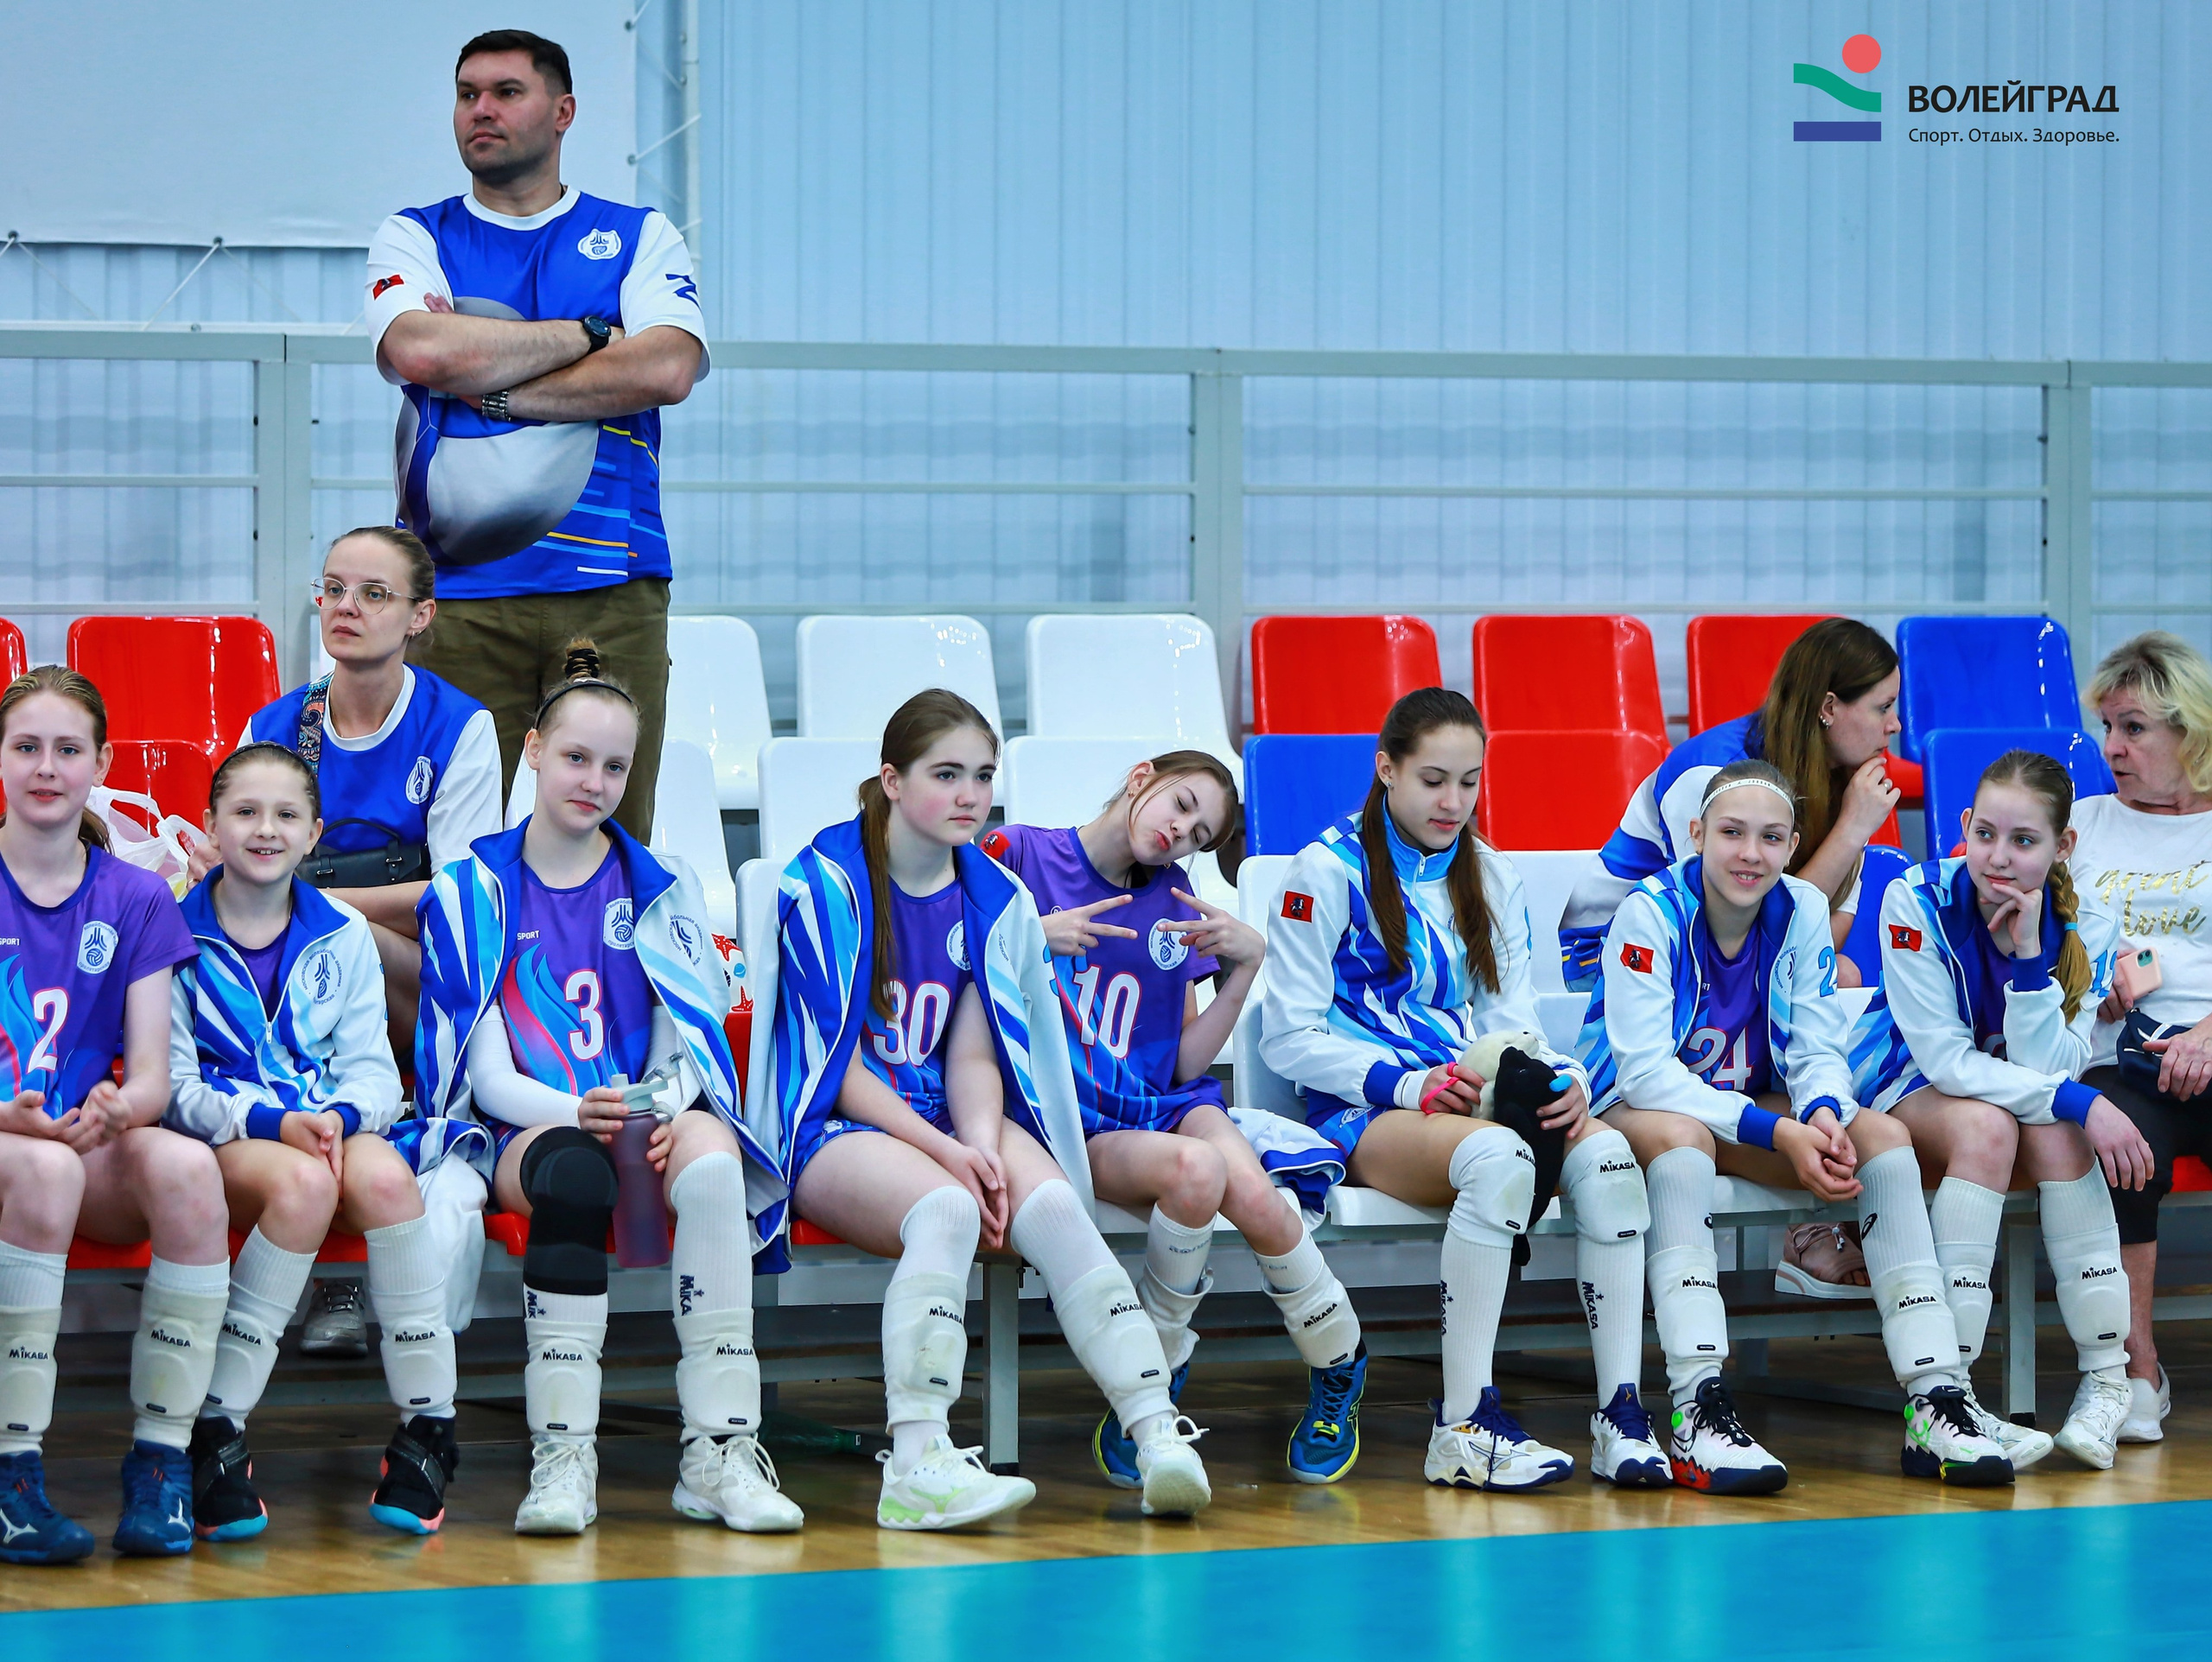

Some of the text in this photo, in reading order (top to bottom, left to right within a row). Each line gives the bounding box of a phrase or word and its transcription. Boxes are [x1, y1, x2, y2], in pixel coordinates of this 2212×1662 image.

[2123, 887, 2208, 937] love
[517, 930, 539, 940] SPORT
[565, 970, 605, 1062] 3
[1073, 964, 1141, 1059] 10
[27, 986, 69, 1075] 2
[873, 979, 951, 1066] 30
[1688, 1025, 1753, 1090] 24
[1600, 1159, 1636, 1173] MIKASA
[1682, 1276, 1716, 1289] MIKASA
[2082, 1266, 2117, 1280] MIKASA
[1953, 1277, 1986, 1289] MIKASA
[527, 1291, 543, 1318] MIK
[680, 1275, 702, 1316] MIKA
[1899, 1296, 1936, 1310] MIKASA
[929, 1305, 963, 1324] MIKASA
[1582, 1281, 1602, 1330] MIKASA
[1303, 1303, 1338, 1329] MIKASA
[151, 1329, 191, 1348] MIKASA
[222, 1323, 262, 1346] MIKASA
[396, 1330, 435, 1342] MIKASA
[9, 1346, 48, 1360] MIKASA
[543, 1348, 582, 1361] MIKASA
[716, 1342, 753, 1356] MIKASA
